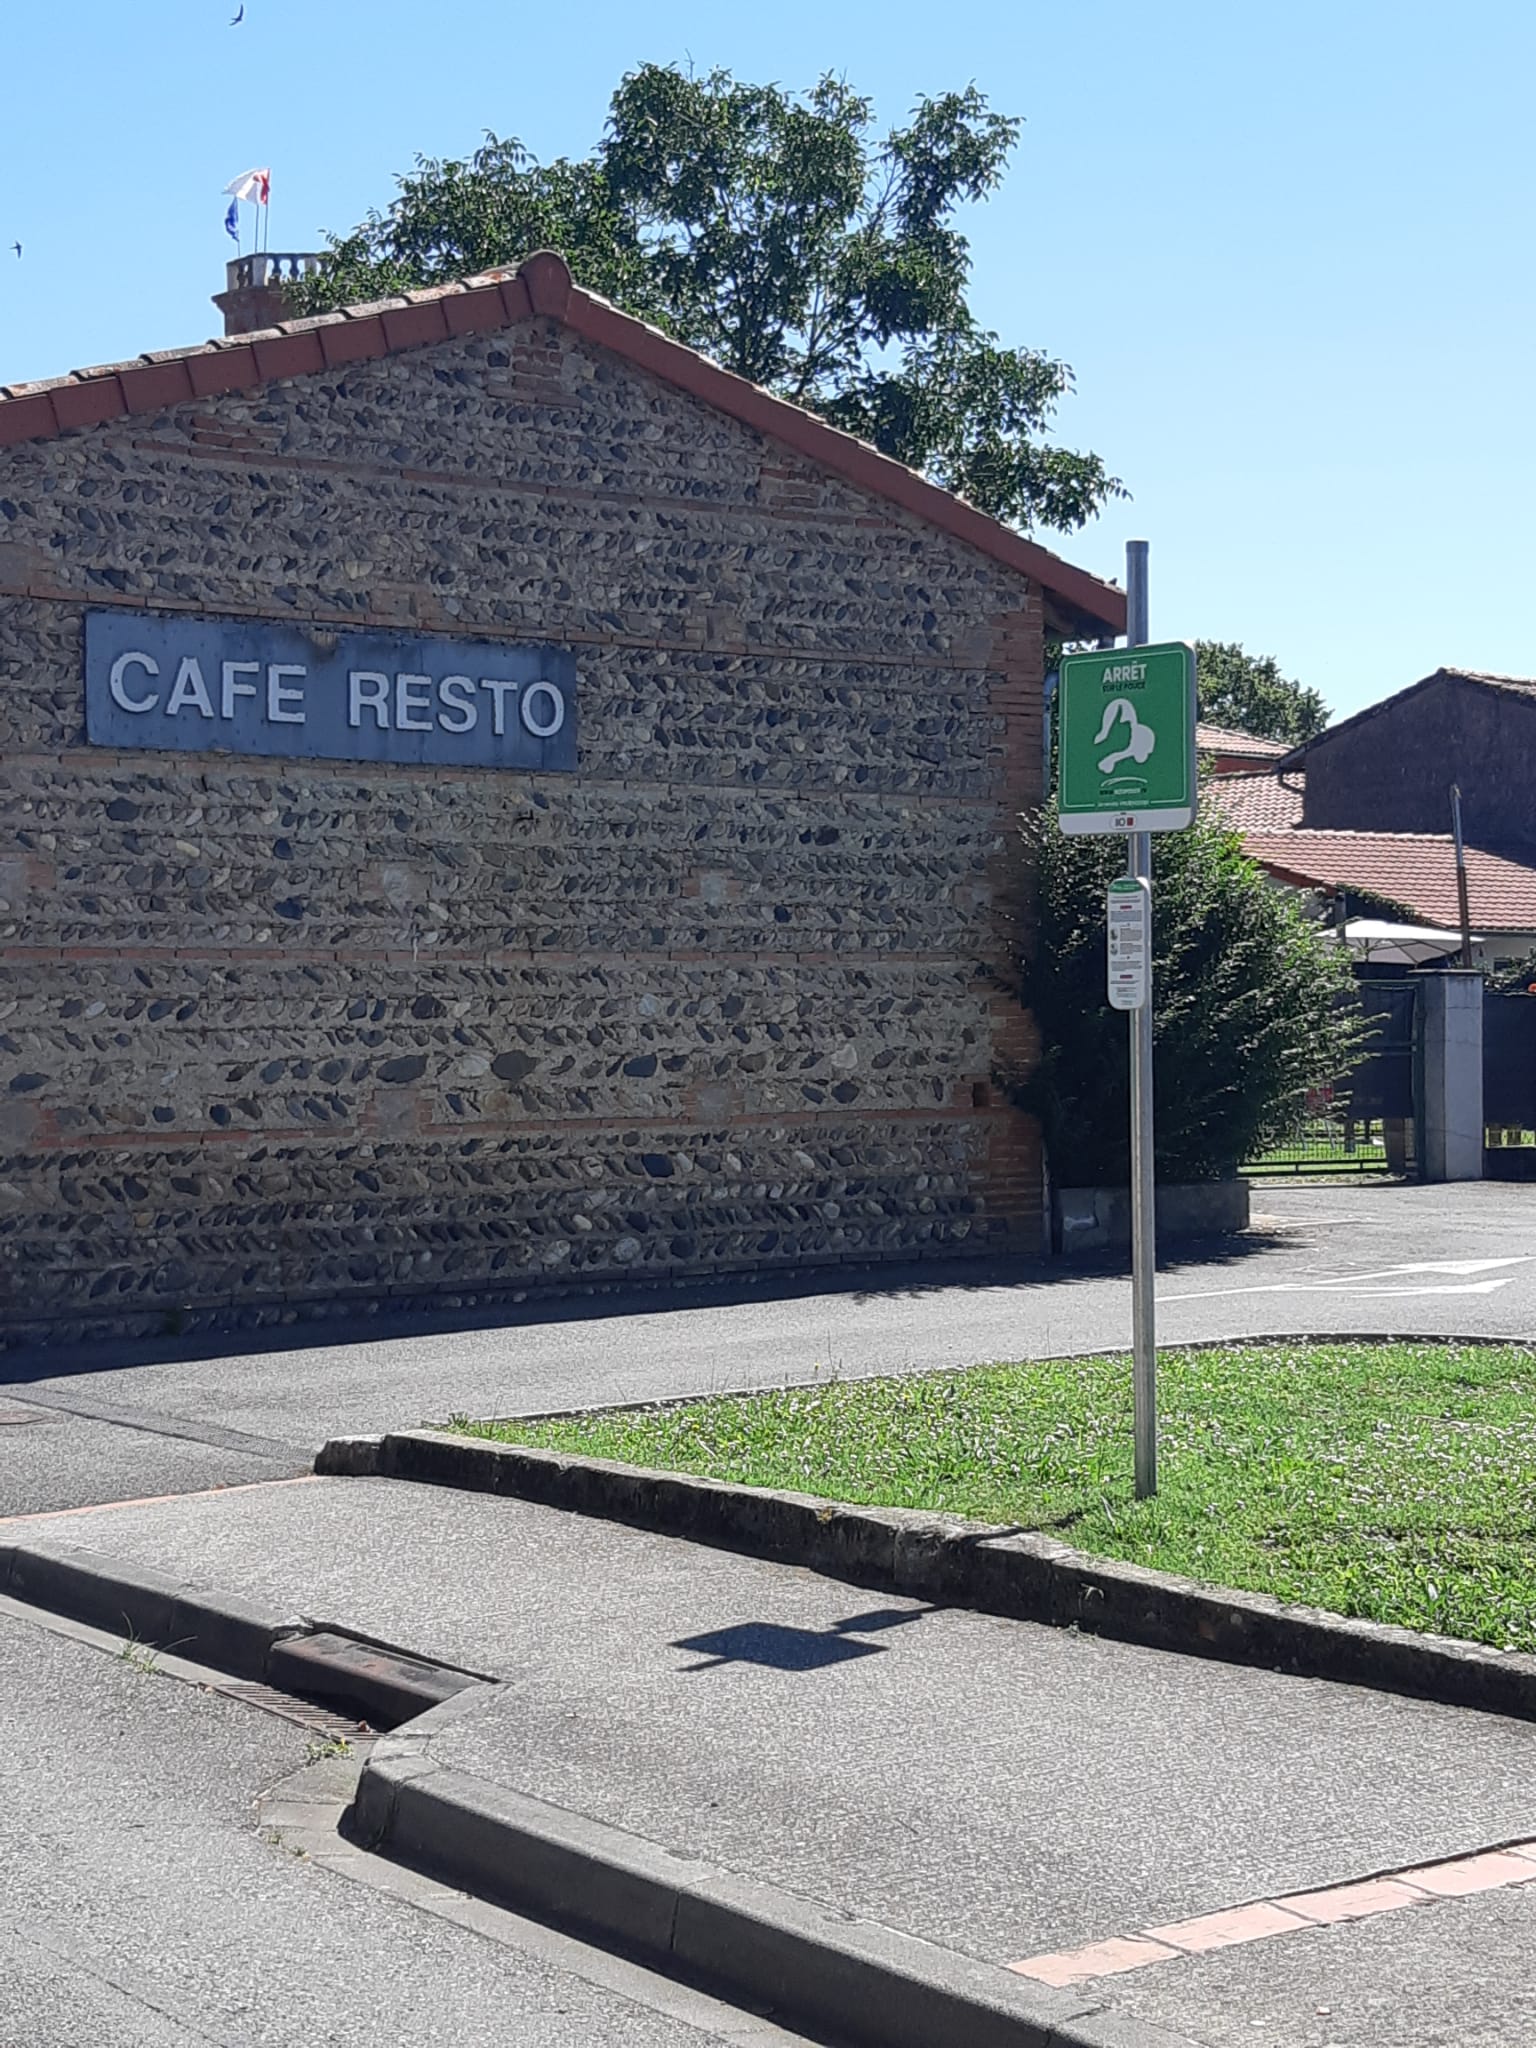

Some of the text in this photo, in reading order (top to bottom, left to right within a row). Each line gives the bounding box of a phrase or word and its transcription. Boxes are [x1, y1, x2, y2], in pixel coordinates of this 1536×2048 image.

[109, 651, 566, 738] CAFE RESTO
[1103, 660, 1147, 683] ARRÊT
